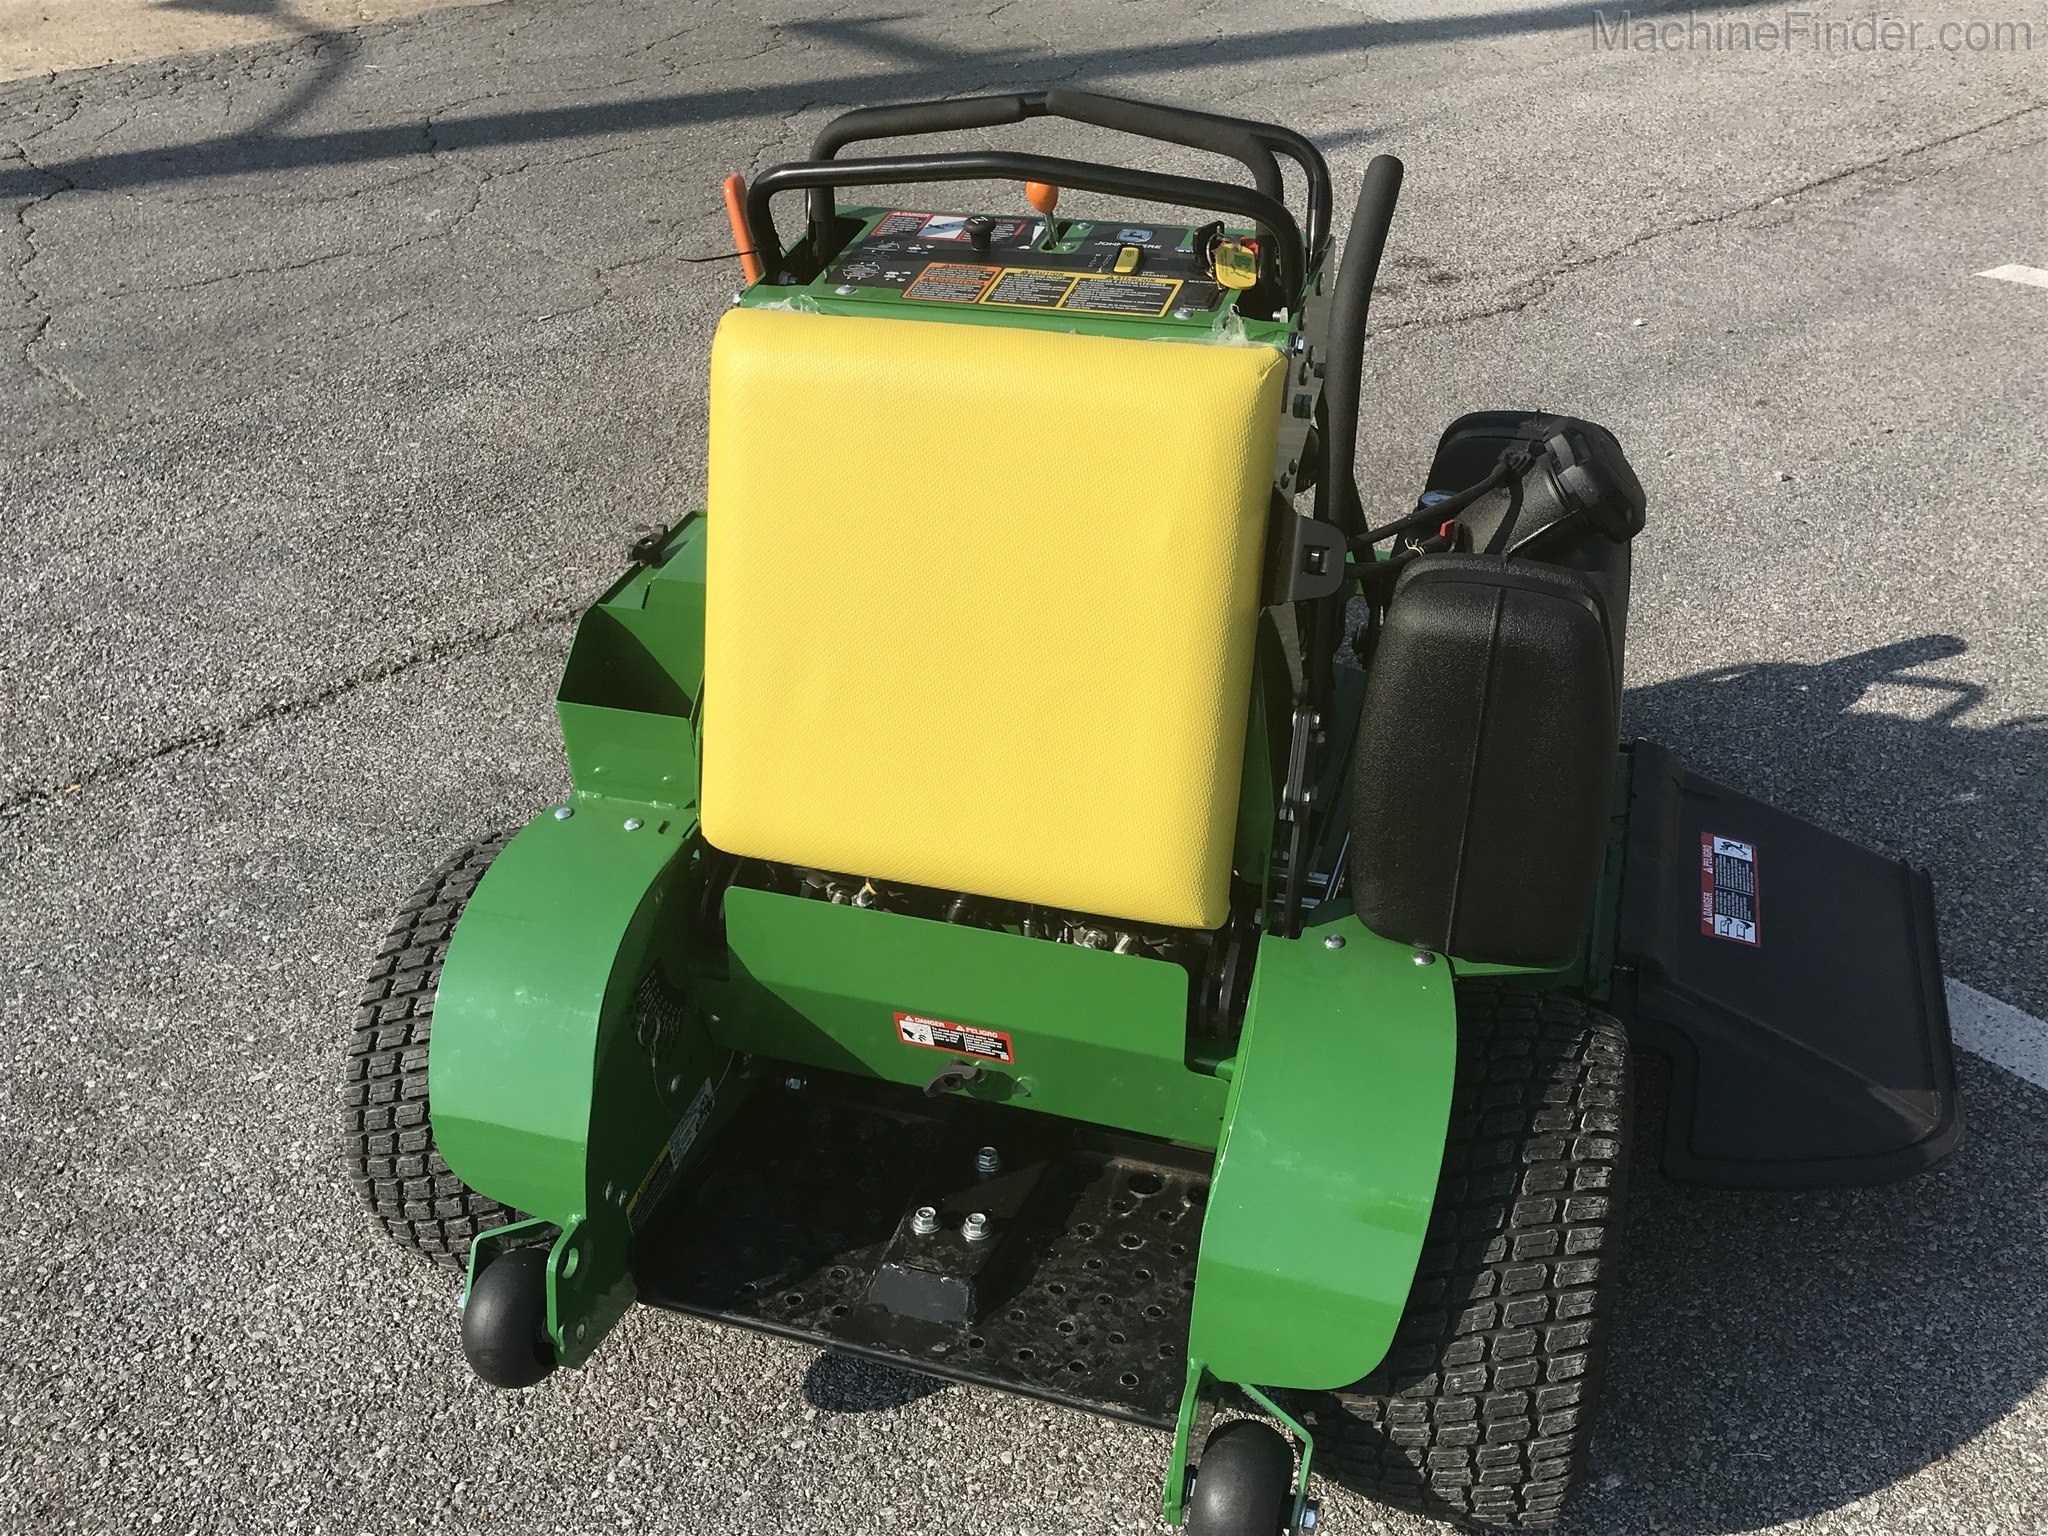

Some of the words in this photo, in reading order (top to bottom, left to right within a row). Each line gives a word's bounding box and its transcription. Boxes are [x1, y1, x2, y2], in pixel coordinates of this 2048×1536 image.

[1703, 844, 1713, 868] PELIGRO
[1703, 892, 1713, 917] DANGER
[914, 1017, 945, 1028] DANGER
[965, 1026, 998, 1038] PELIGRO
